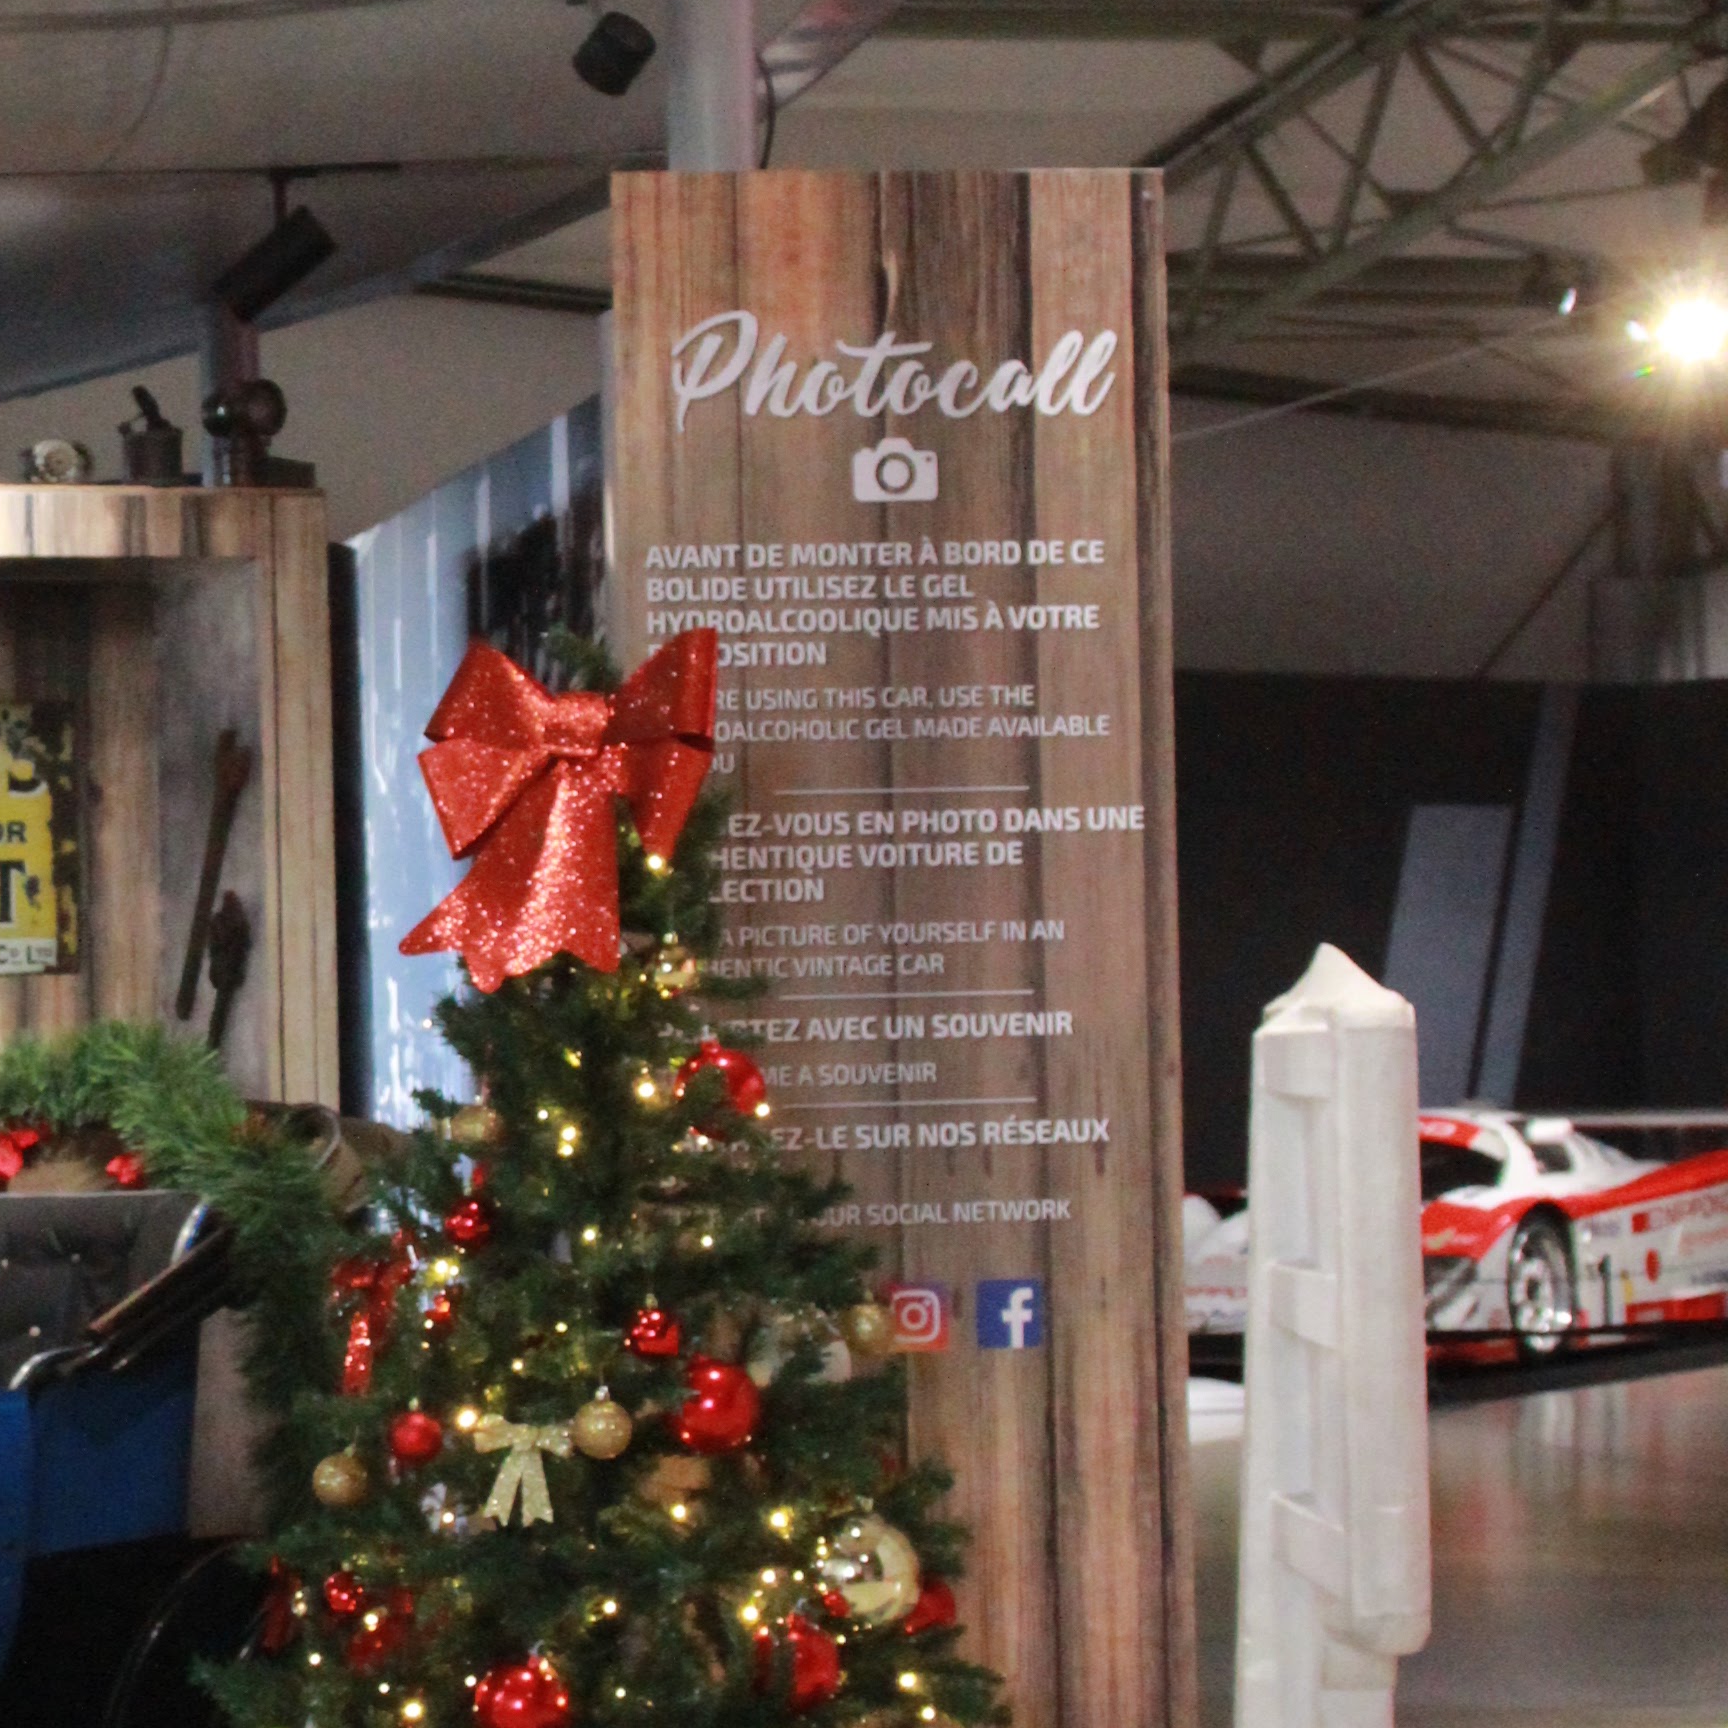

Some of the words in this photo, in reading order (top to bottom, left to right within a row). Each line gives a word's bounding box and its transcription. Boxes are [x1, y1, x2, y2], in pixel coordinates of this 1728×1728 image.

[673, 310, 1119, 434] Photocall
[646, 544, 740, 569] AVANT
[746, 544, 783, 569] DE
[791, 542, 913, 567] MONTER
[918, 535, 938, 566] À
[944, 540, 1021, 566] BORD
[1027, 540, 1065, 565] DE
[1070, 539, 1105, 564] CE
[646, 576, 747, 602] BOLIDE
[754, 575, 877, 601] UTILISEZ
[884, 575, 916, 599] LE
[923, 574, 975, 599] GEL
[926, 606, 979, 631] MIS
[983, 600, 1004, 631] À
[1008, 603, 1101, 630] VOTRE
[746, 687, 818, 711] USING
[824, 686, 876, 709] THIS
[882, 685, 934, 710] CAR,
[939, 685, 984, 708] USE
[990, 684, 1035, 707] THE
[865, 718, 908, 740] GEL
[914, 717, 982, 739] MADE
[986, 714, 1111, 737] AVAILABLE
[858, 810, 895, 836] EN
[902, 808, 998, 834] PHOTO
[1003, 806, 1081, 833] DANS
[1086, 804, 1146, 832] UNE
[859, 841, 979, 869] VOITURE
[986, 840, 1024, 866] DE
[739, 924, 838, 947] PICTURE
[843, 923, 874, 946] OF
[878, 922, 996, 945] YOURSELF
[1002, 920, 1026, 942] IN
[1030, 920, 1065, 941] AN
[792, 954, 893, 978] VINTAGE
[898, 952, 945, 975] CAR
[806, 1015, 878, 1041] AVEC
[884, 1015, 925, 1040] UN
[931, 1011, 1073, 1039] SOUVENIR
[799, 1064, 815, 1086] A
[820, 1062, 937, 1087] SOUVENIR
[855, 1123, 911, 1149] SUR
[918, 1122, 976, 1147] NOS
[983, 1114, 1110, 1145] RÉSEAUX
[866, 1202, 947, 1226] SOCIAL
[954, 1199, 1071, 1223] NETWORK
